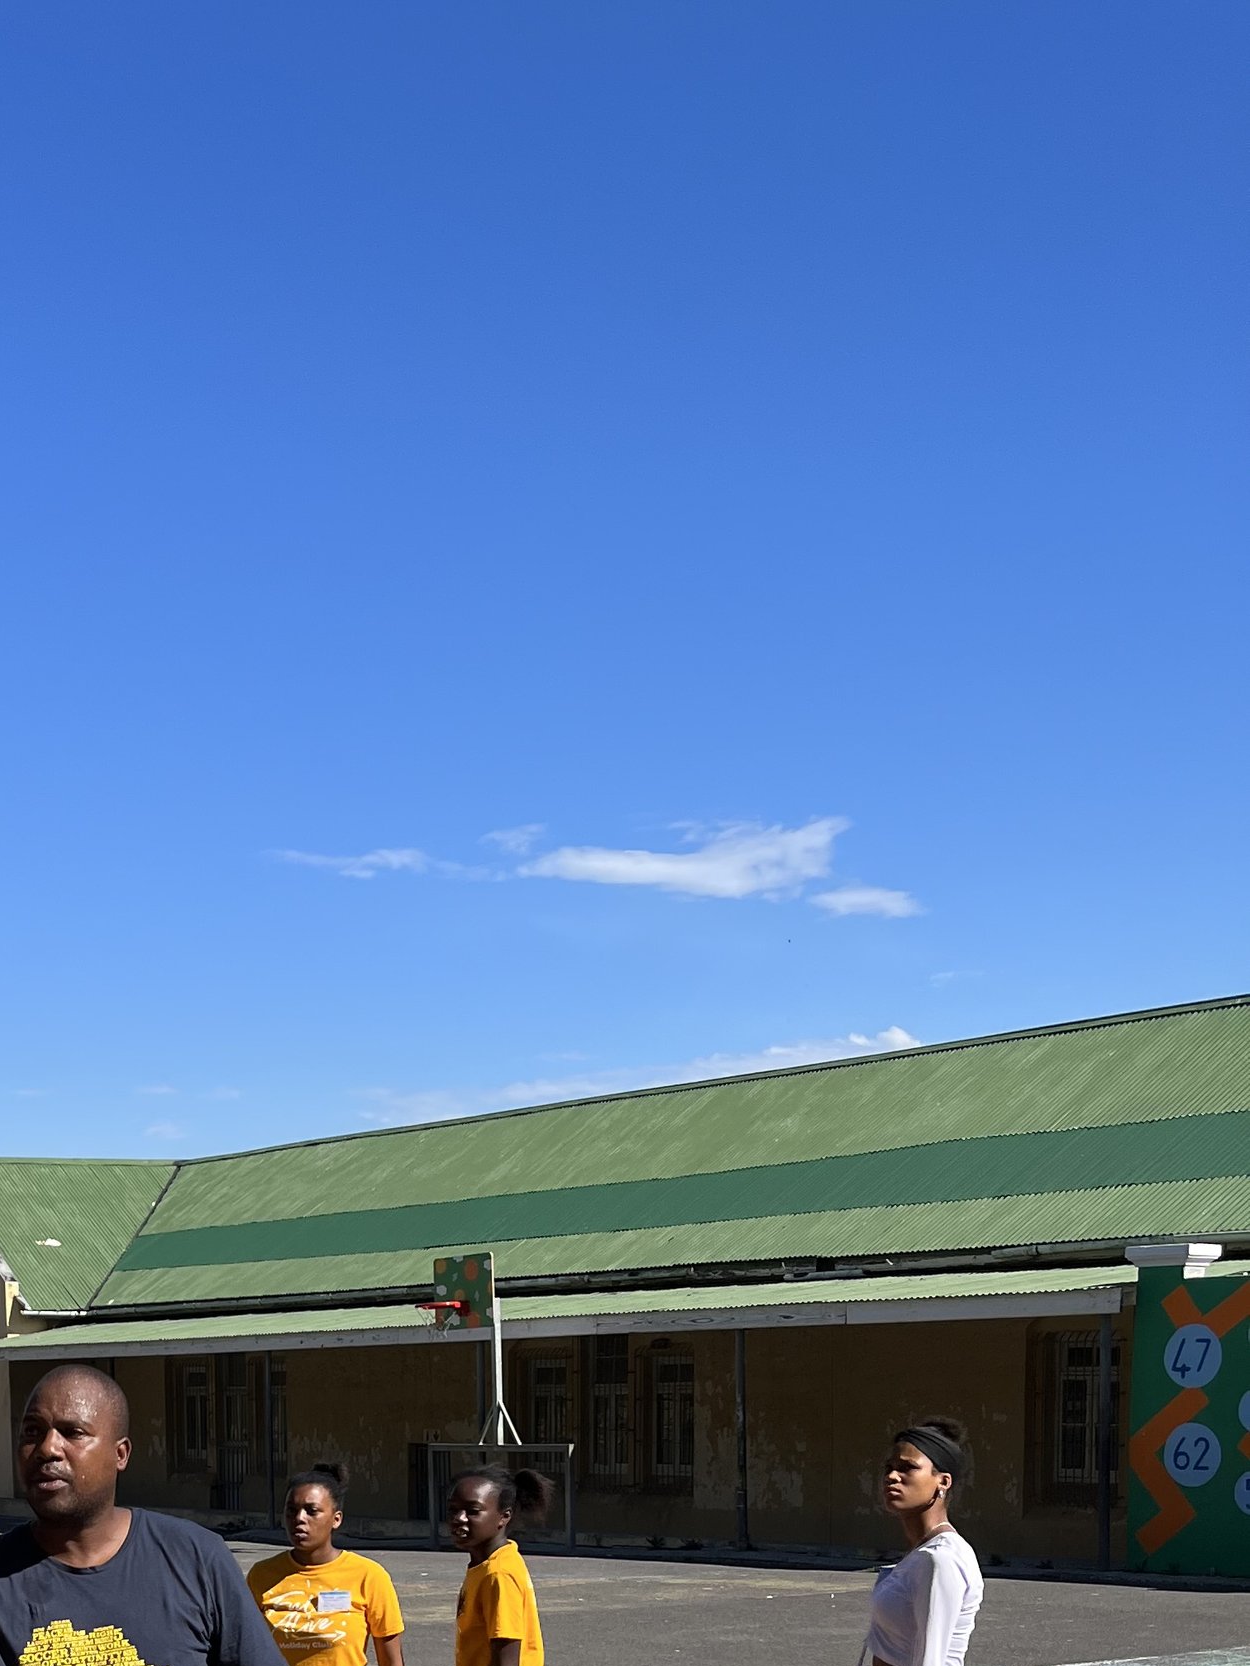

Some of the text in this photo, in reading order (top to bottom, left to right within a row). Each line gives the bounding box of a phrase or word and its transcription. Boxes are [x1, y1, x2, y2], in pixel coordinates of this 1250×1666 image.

[1170, 1338, 1211, 1379] 47
[1172, 1436, 1211, 1471] 62
[32, 1629, 64, 1642] PEACE
[18, 1648, 70, 1664] SOCCER
